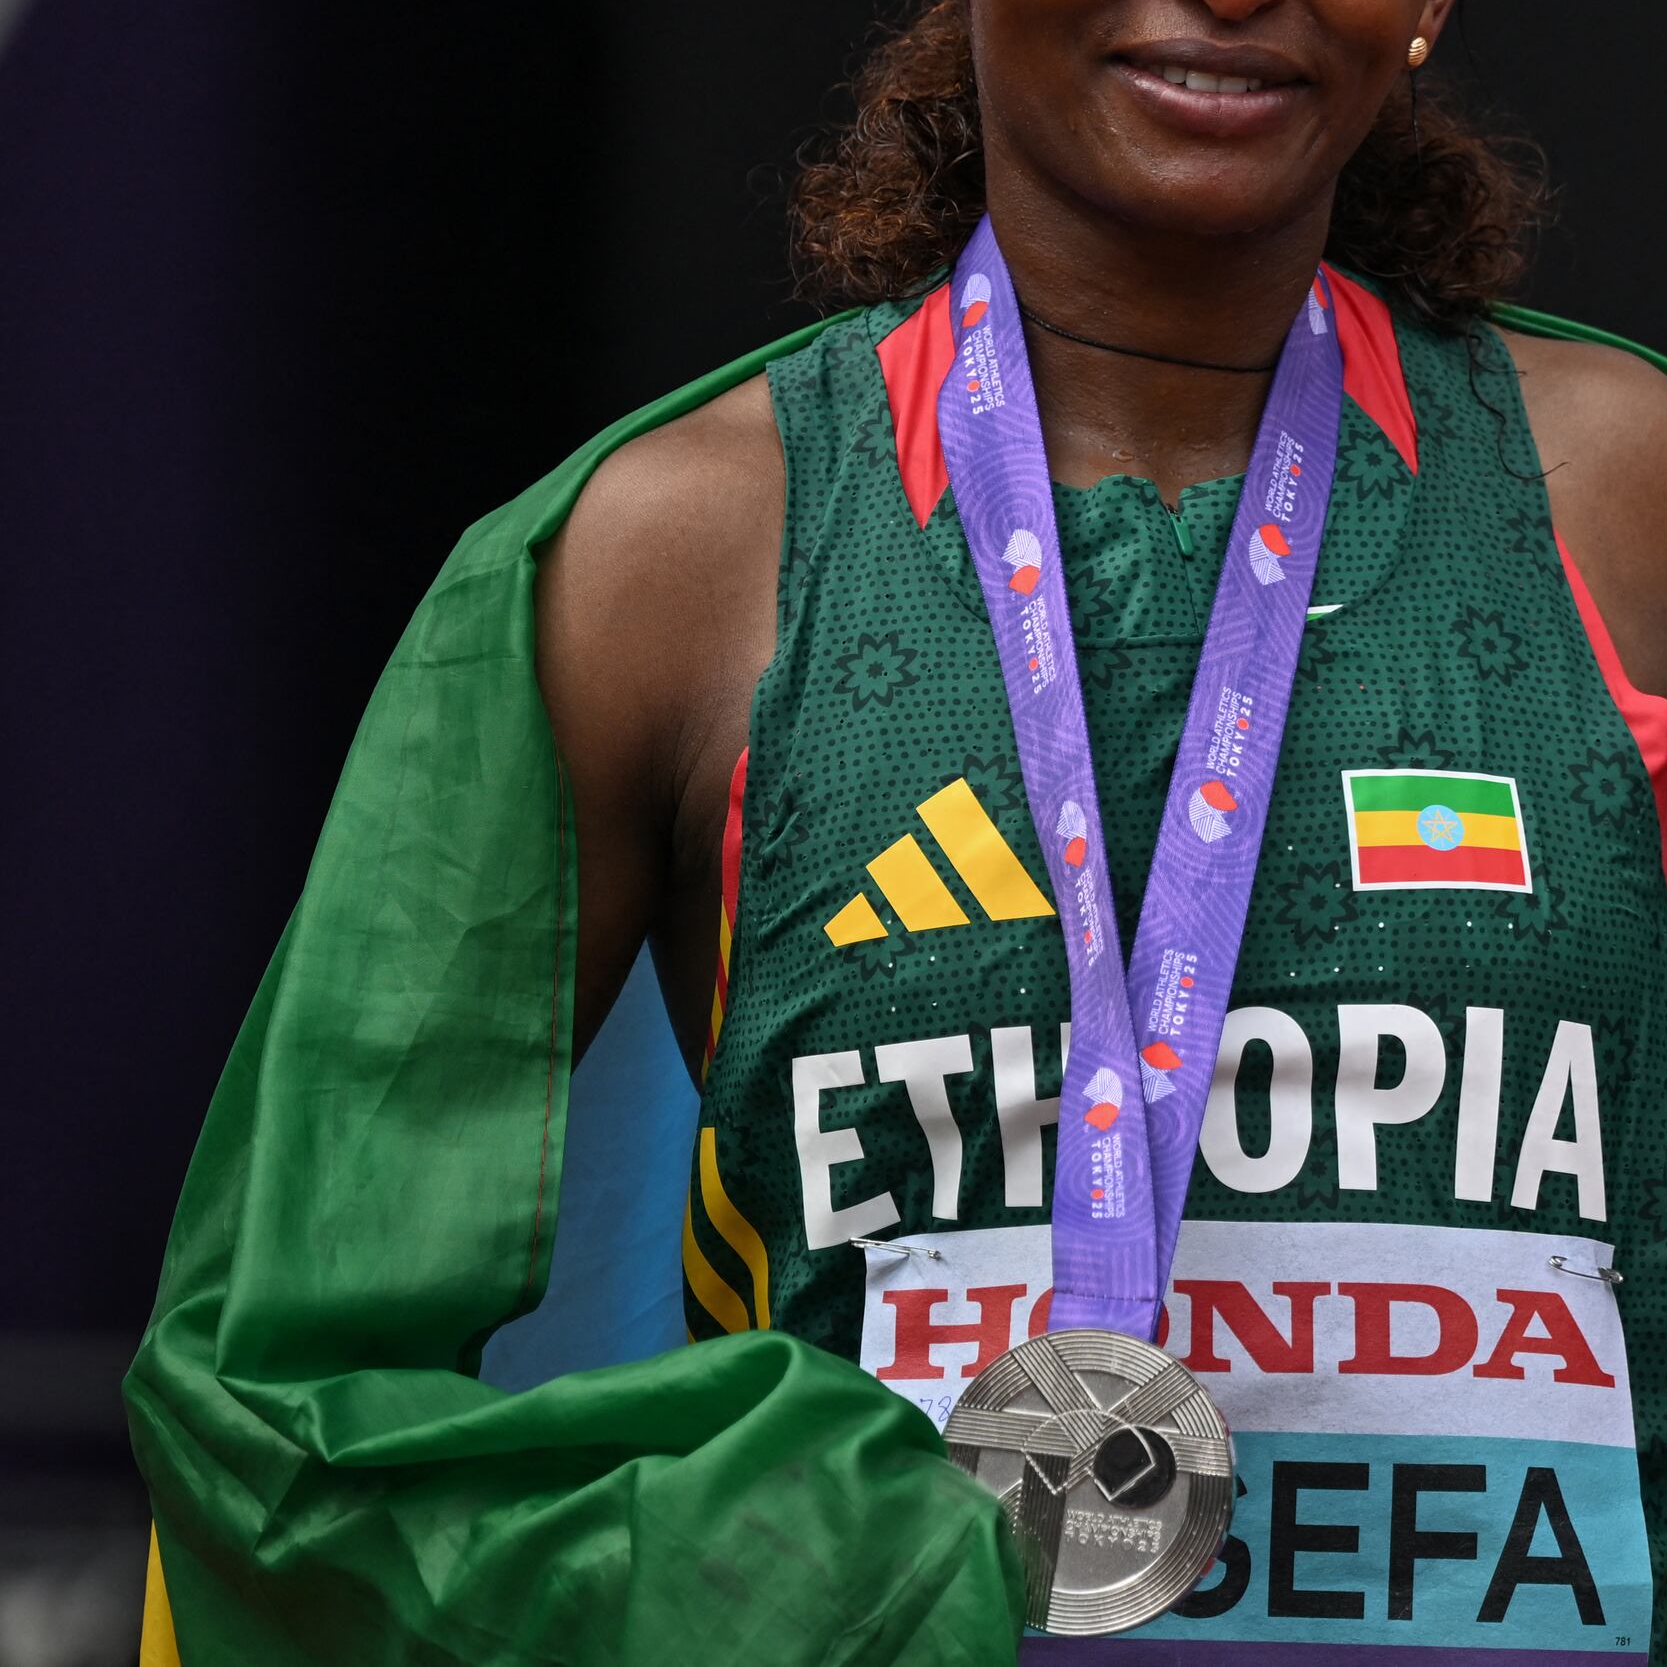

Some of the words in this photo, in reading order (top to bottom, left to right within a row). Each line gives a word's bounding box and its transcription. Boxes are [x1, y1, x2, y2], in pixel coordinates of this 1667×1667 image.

[970, 329, 995, 411] CHAMPIONSHIPS
[981, 324, 995, 357] WORLD
[986, 357, 1005, 407] ATHLETICS
[1264, 478, 1278, 511] WORLD
[1272, 429, 1288, 479] ATHLETICS
[1272, 436, 1296, 518] CHAMPIONSHIPS
[1027, 599, 1048, 688] CHAMPIONSHIPS
[1035, 593, 1048, 630] WORLD
[1041, 630, 1057, 683] ATHLETICS
[1205, 735, 1220, 769] WORLD
[1214, 685, 1232, 736] ATHLETICS
[1215, 690, 1241, 774] CHAMPIONSHIPS
[1146, 998, 1162, 1031] WORLD
[1154, 948, 1174, 998] ATHLETICS
[1158, 951, 1185, 1035] CHAMPIONSHIPS
[791, 1004, 1607, 1251] ETHOPIA
[1112, 1133, 1122, 1168] WORLD
[1101, 1136, 1114, 1218] CHAMPIONSHIPS
[1114, 1169, 1125, 1218] ATHLETICS
[1615, 1637, 1631, 1646] 781
